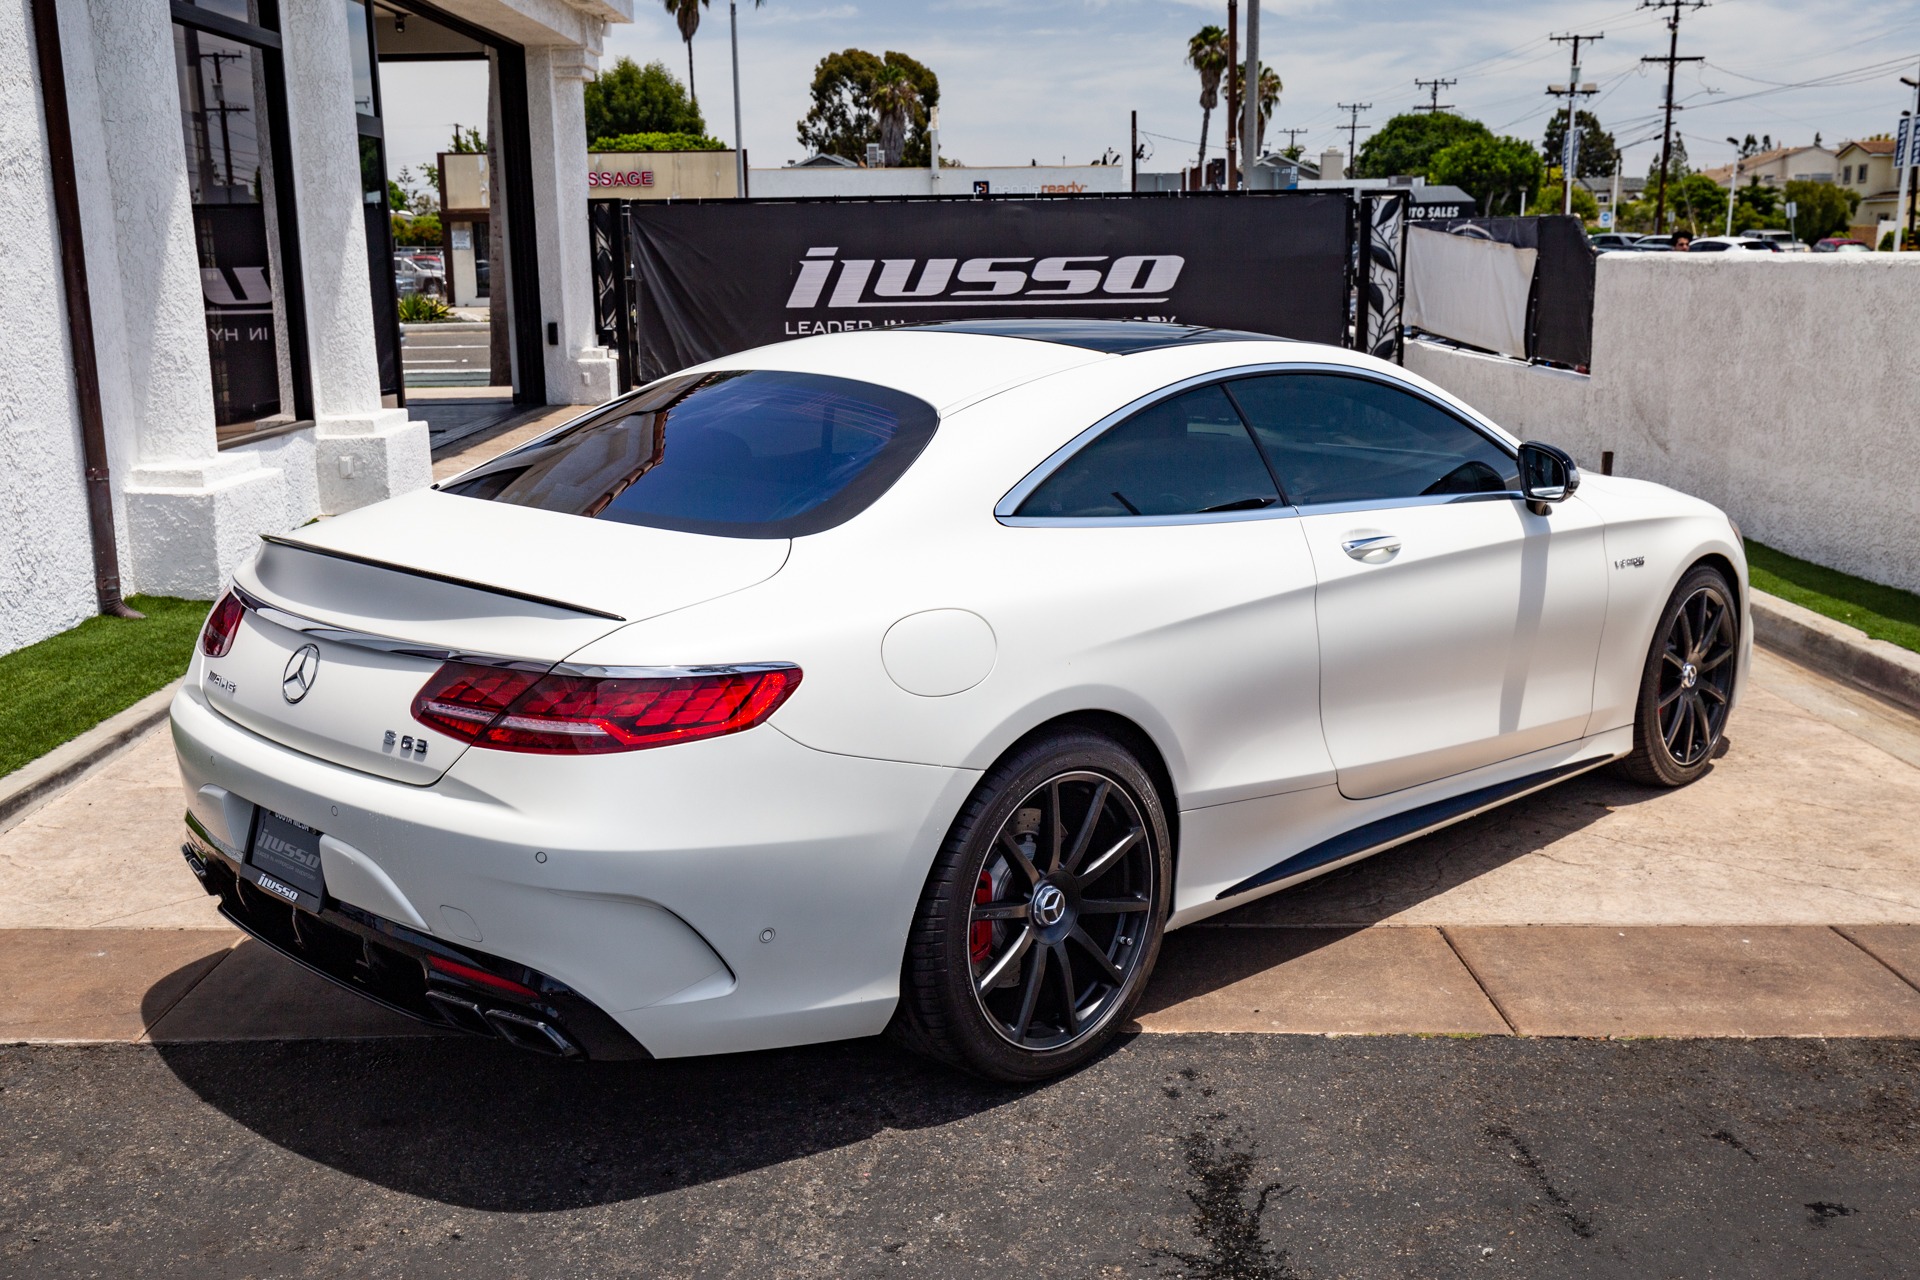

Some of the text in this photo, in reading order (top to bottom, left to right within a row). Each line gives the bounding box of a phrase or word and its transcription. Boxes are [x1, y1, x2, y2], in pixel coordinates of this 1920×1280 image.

[1427, 206, 1460, 219] SALES
[383, 730, 429, 754] S 63
